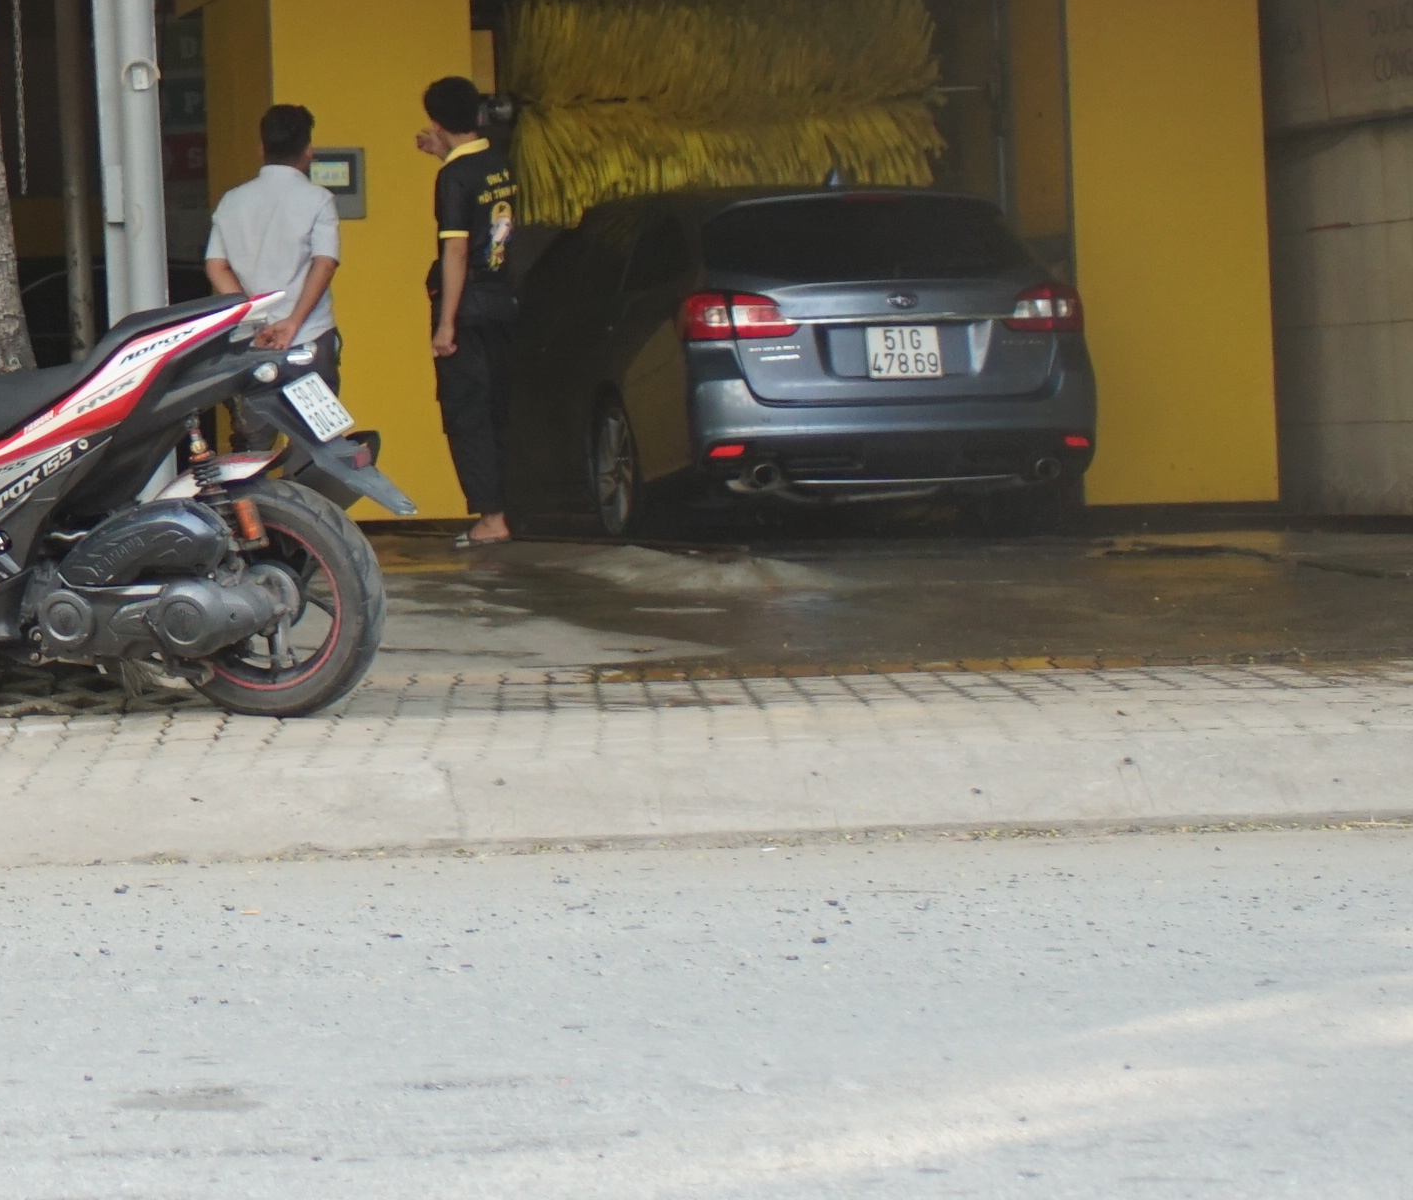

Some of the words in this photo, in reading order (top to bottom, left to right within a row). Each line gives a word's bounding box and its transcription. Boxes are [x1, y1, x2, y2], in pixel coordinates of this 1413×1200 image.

[883, 329, 921, 350] 51G
[873, 352, 939, 374] 478.69
[42, 446, 73, 478] 155
